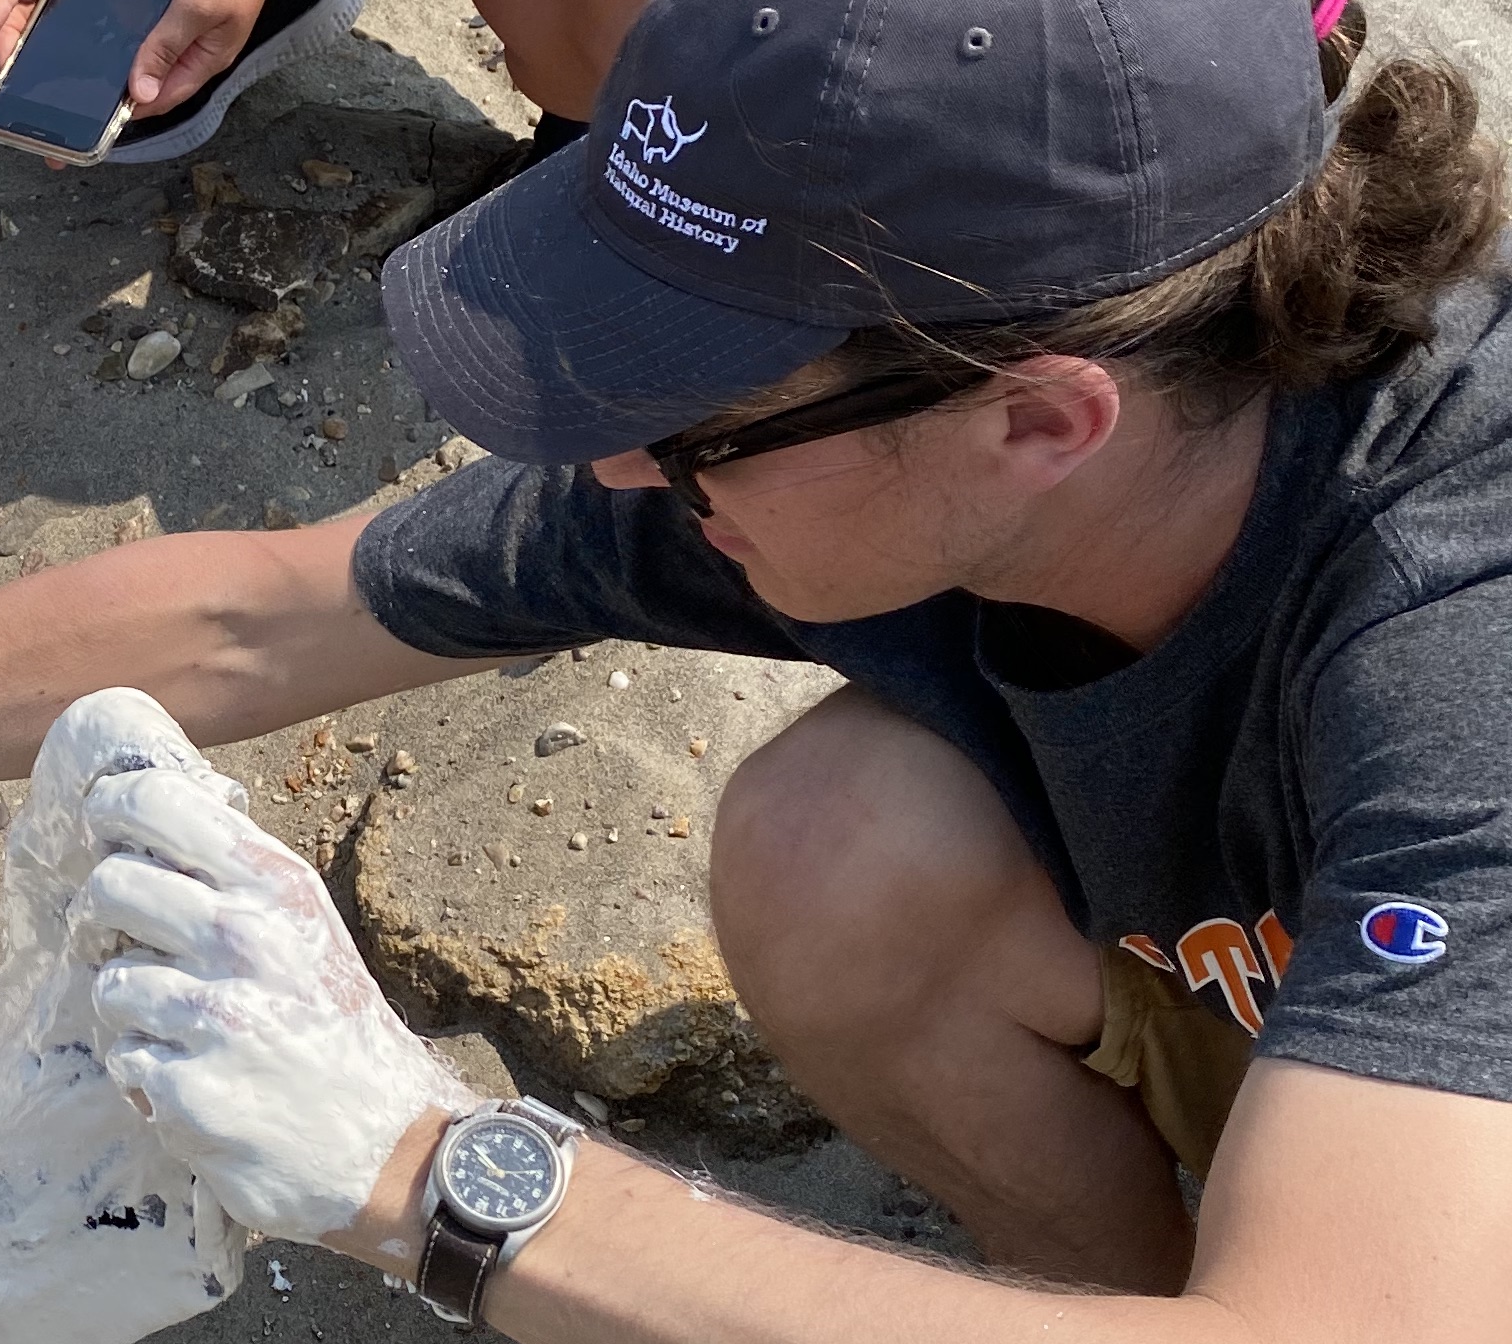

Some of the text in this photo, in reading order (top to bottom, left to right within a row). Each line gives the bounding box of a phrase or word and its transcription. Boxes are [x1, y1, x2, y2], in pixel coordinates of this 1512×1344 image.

[603, 163, 740, 253] Natural History
[608, 142, 768, 236] Idaho Museum of
